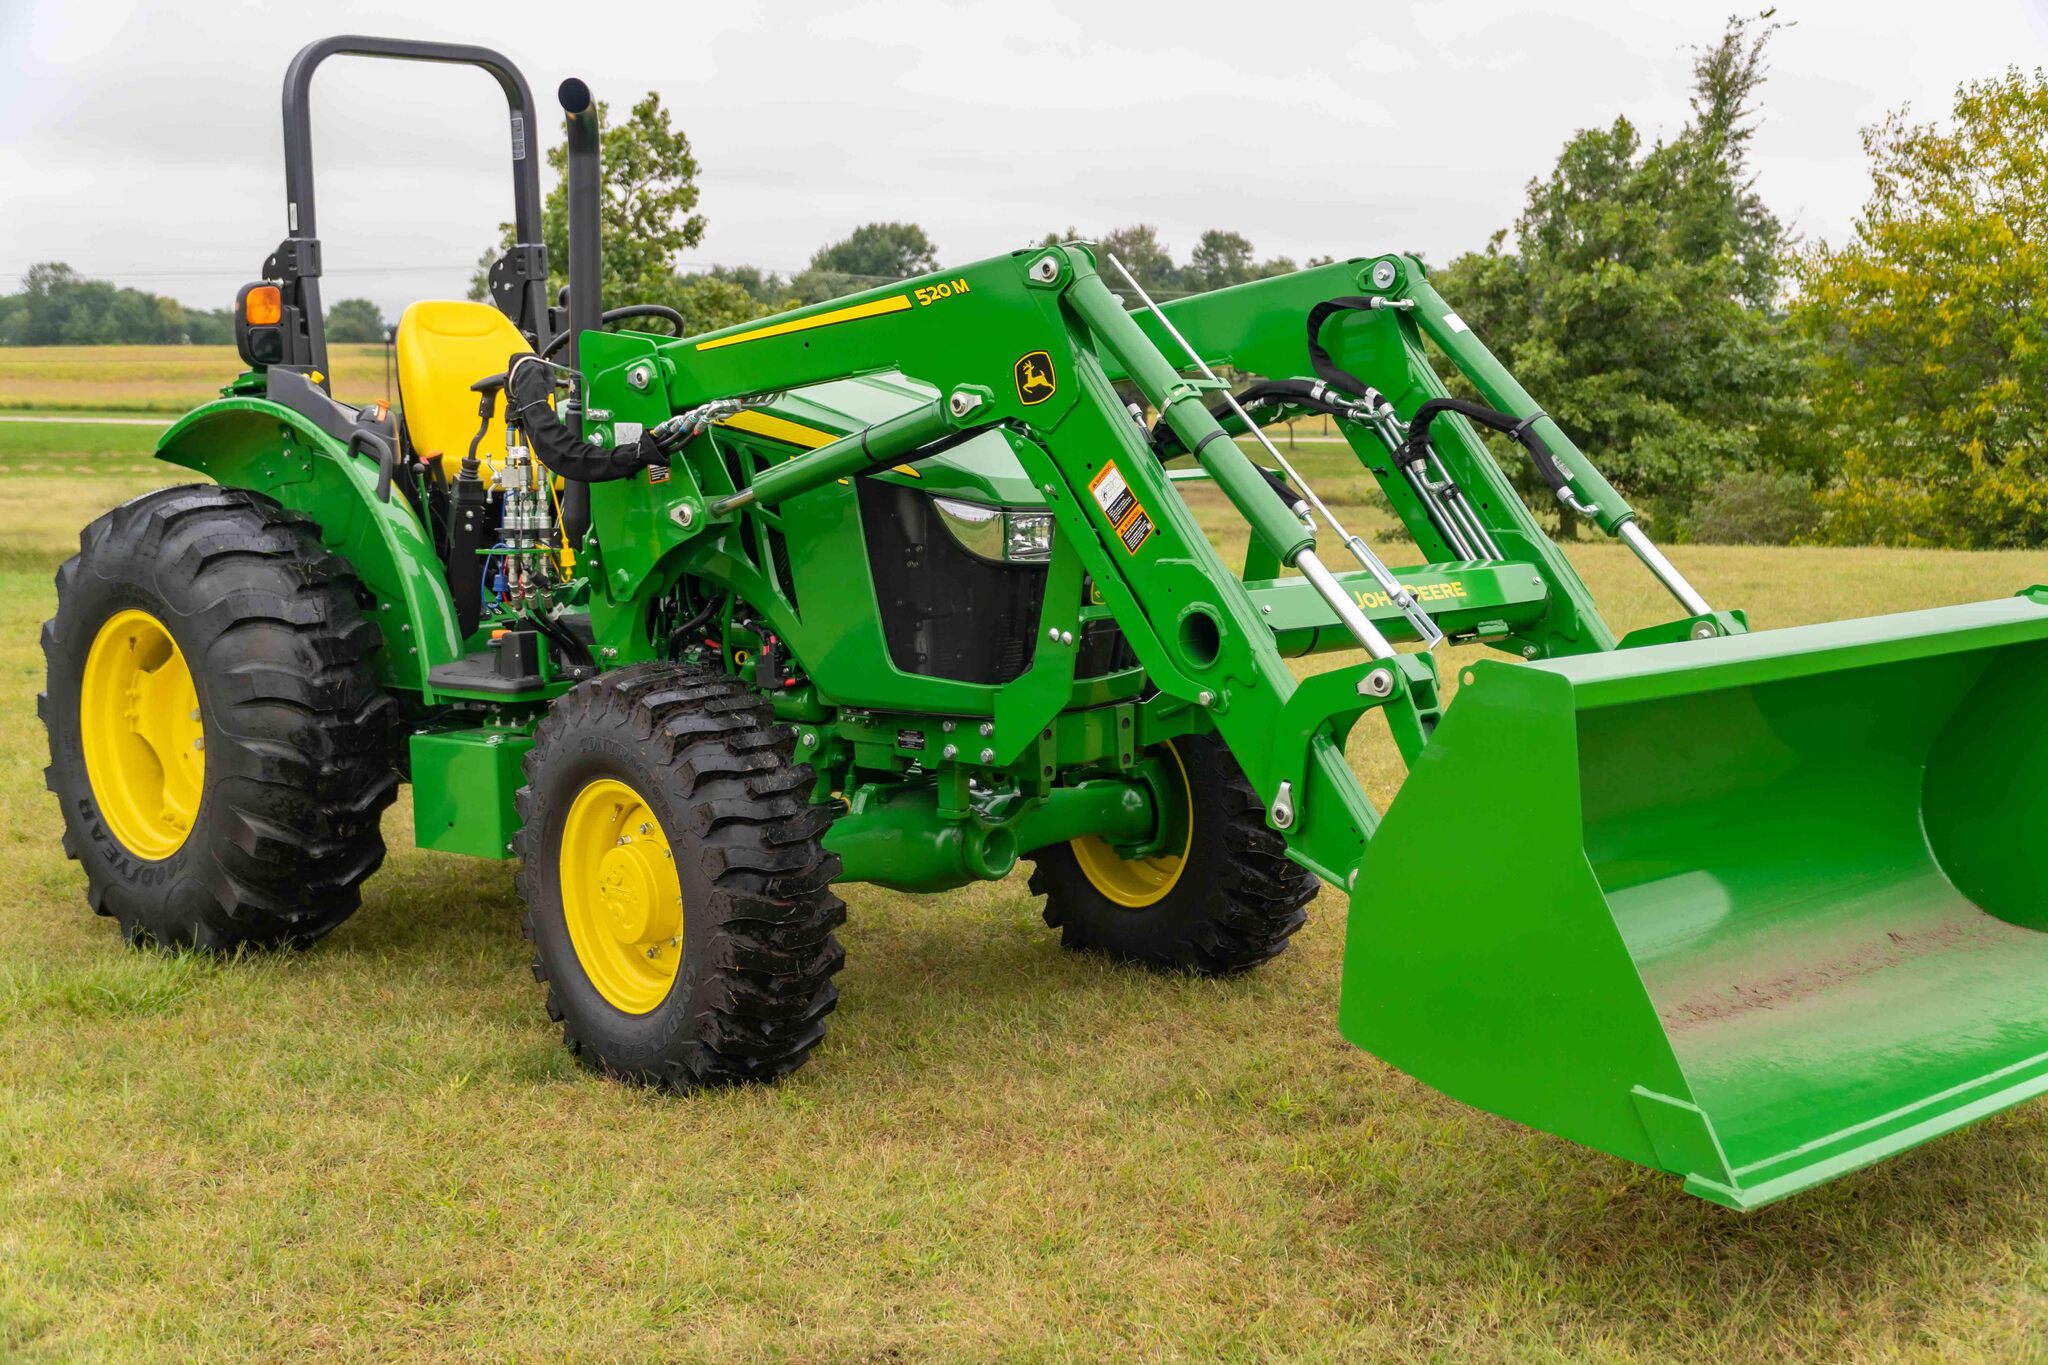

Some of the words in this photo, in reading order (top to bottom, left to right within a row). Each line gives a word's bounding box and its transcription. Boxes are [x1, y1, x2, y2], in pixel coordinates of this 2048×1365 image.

[914, 283, 952, 306] 520
[951, 278, 970, 294] M
[1354, 591, 1393, 610] JOH
[1402, 582, 1468, 602] DEERE
[79, 798, 188, 887] GOODYEAR
